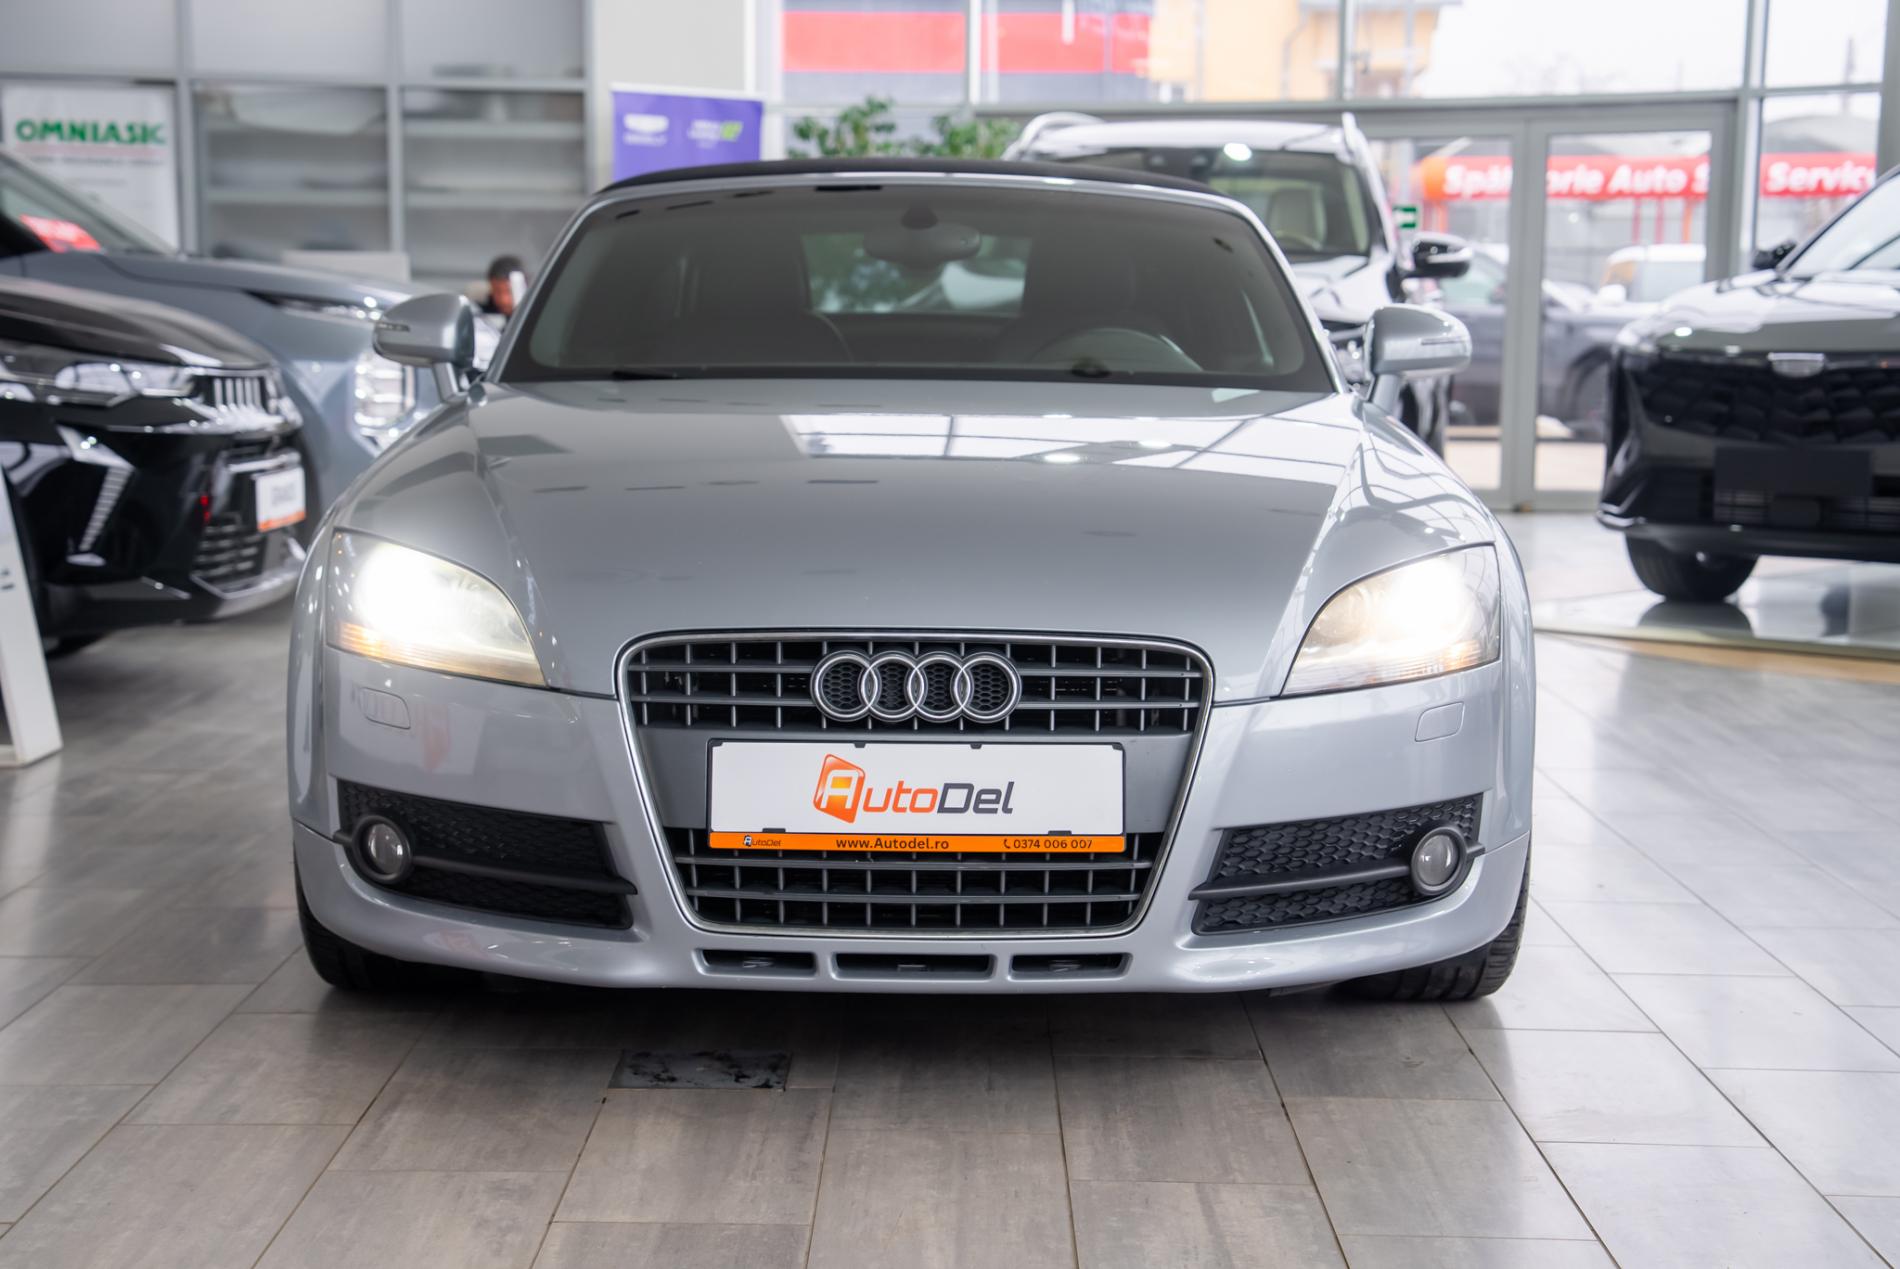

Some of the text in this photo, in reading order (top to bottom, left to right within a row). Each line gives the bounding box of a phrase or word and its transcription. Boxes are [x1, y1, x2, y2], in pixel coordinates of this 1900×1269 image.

[1609, 163, 1688, 195] Auto
[818, 764, 1015, 817] AutoDel
[835, 837, 950, 850] www.Autodel.ro
[1013, 838, 1093, 849] 0374 006 007
